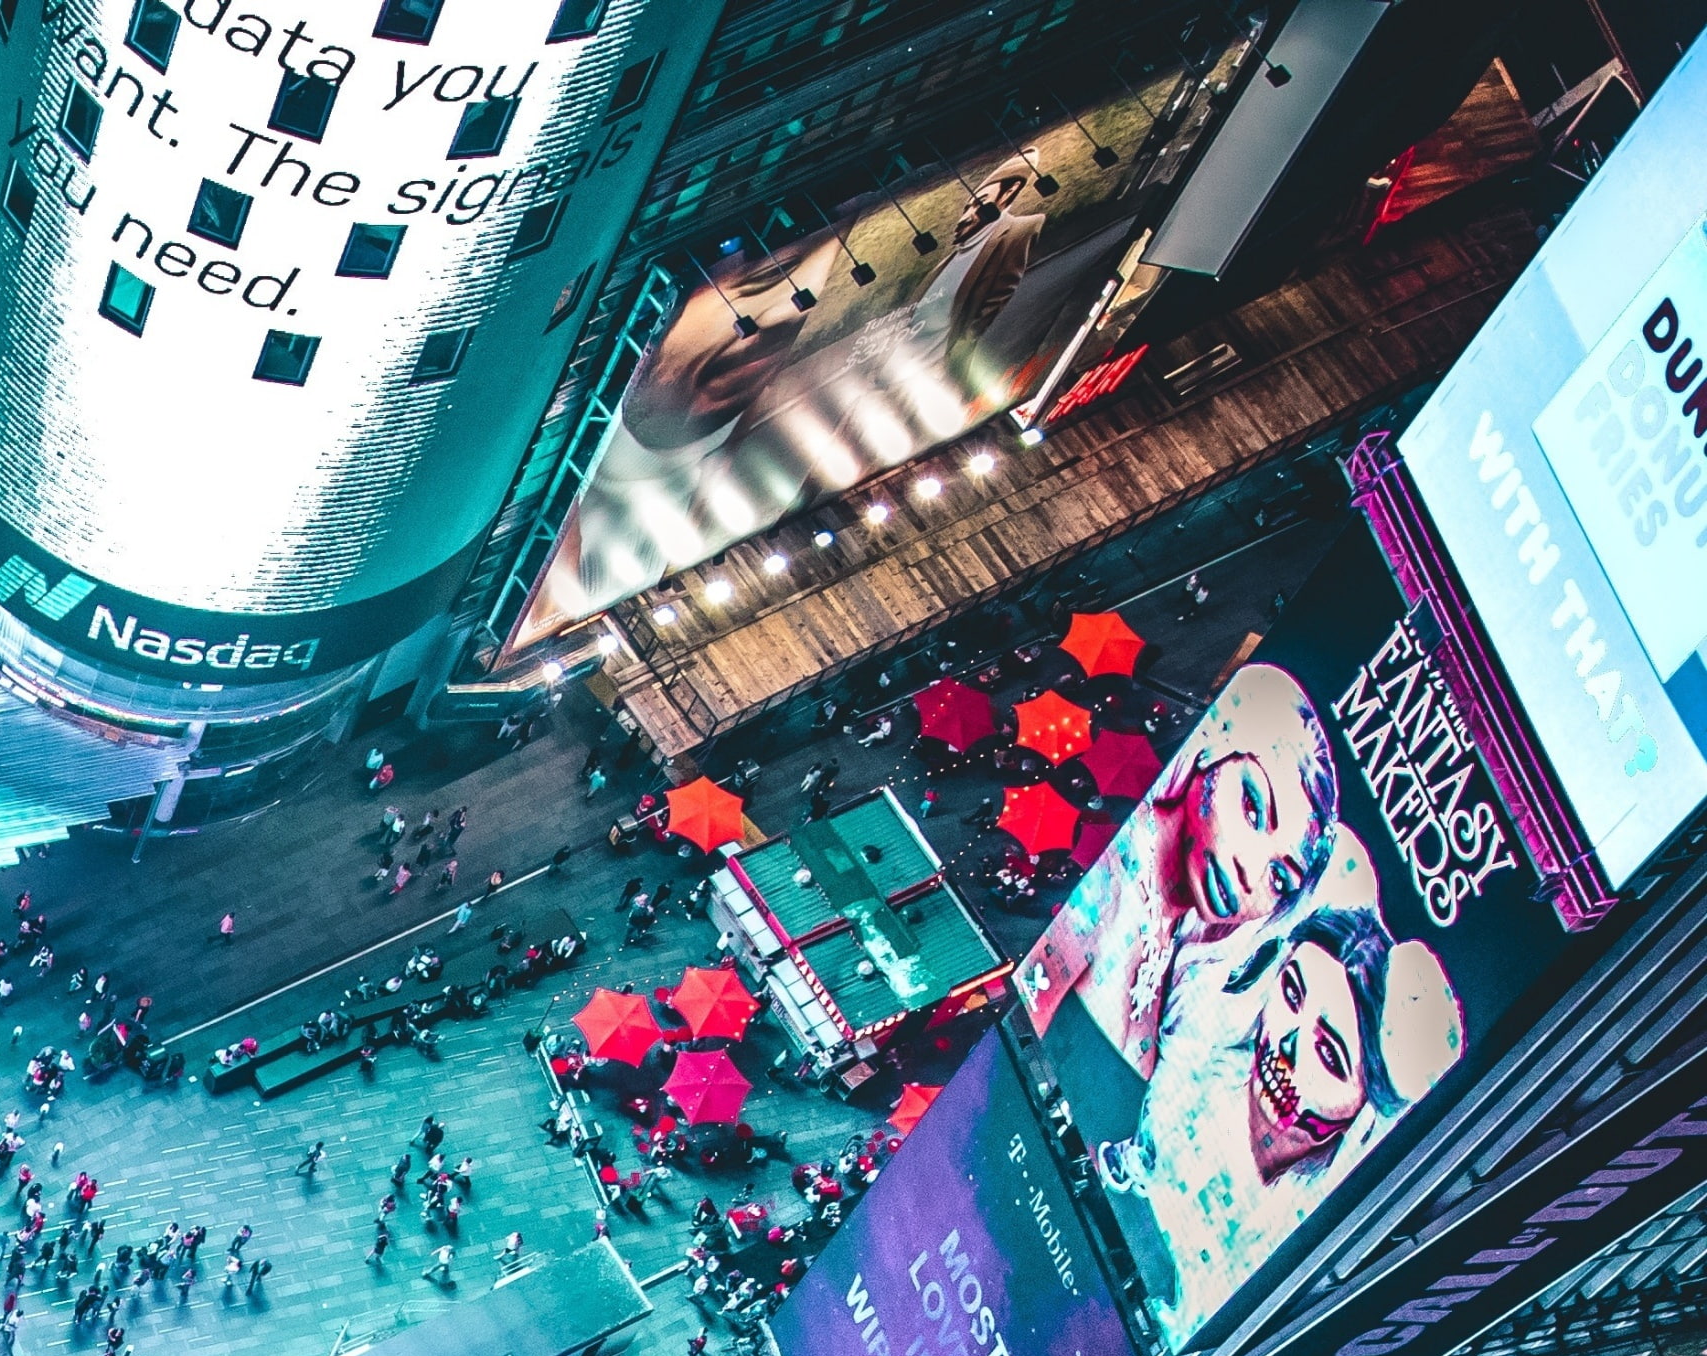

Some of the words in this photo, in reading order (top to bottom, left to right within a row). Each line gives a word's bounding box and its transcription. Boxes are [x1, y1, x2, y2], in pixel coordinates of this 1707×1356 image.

[43, 8, 181, 148] want.
[226, 124, 359, 206] The
[184, 0, 355, 87] data
[384, 60, 539, 111] you
[8, 98, 97, 214] you
[110, 211, 300, 316] need.
[1642, 296, 1707, 460] DUN
[1467, 409, 1561, 586] WITH
[1575, 381, 1668, 547] FRIES
[88, 606, 321, 669] Nasdaq
[1331, 672, 1471, 929] MAKERS
[1369, 619, 1518, 898] FANTASY
[1522, 1095, 1707, 1224] DUT
